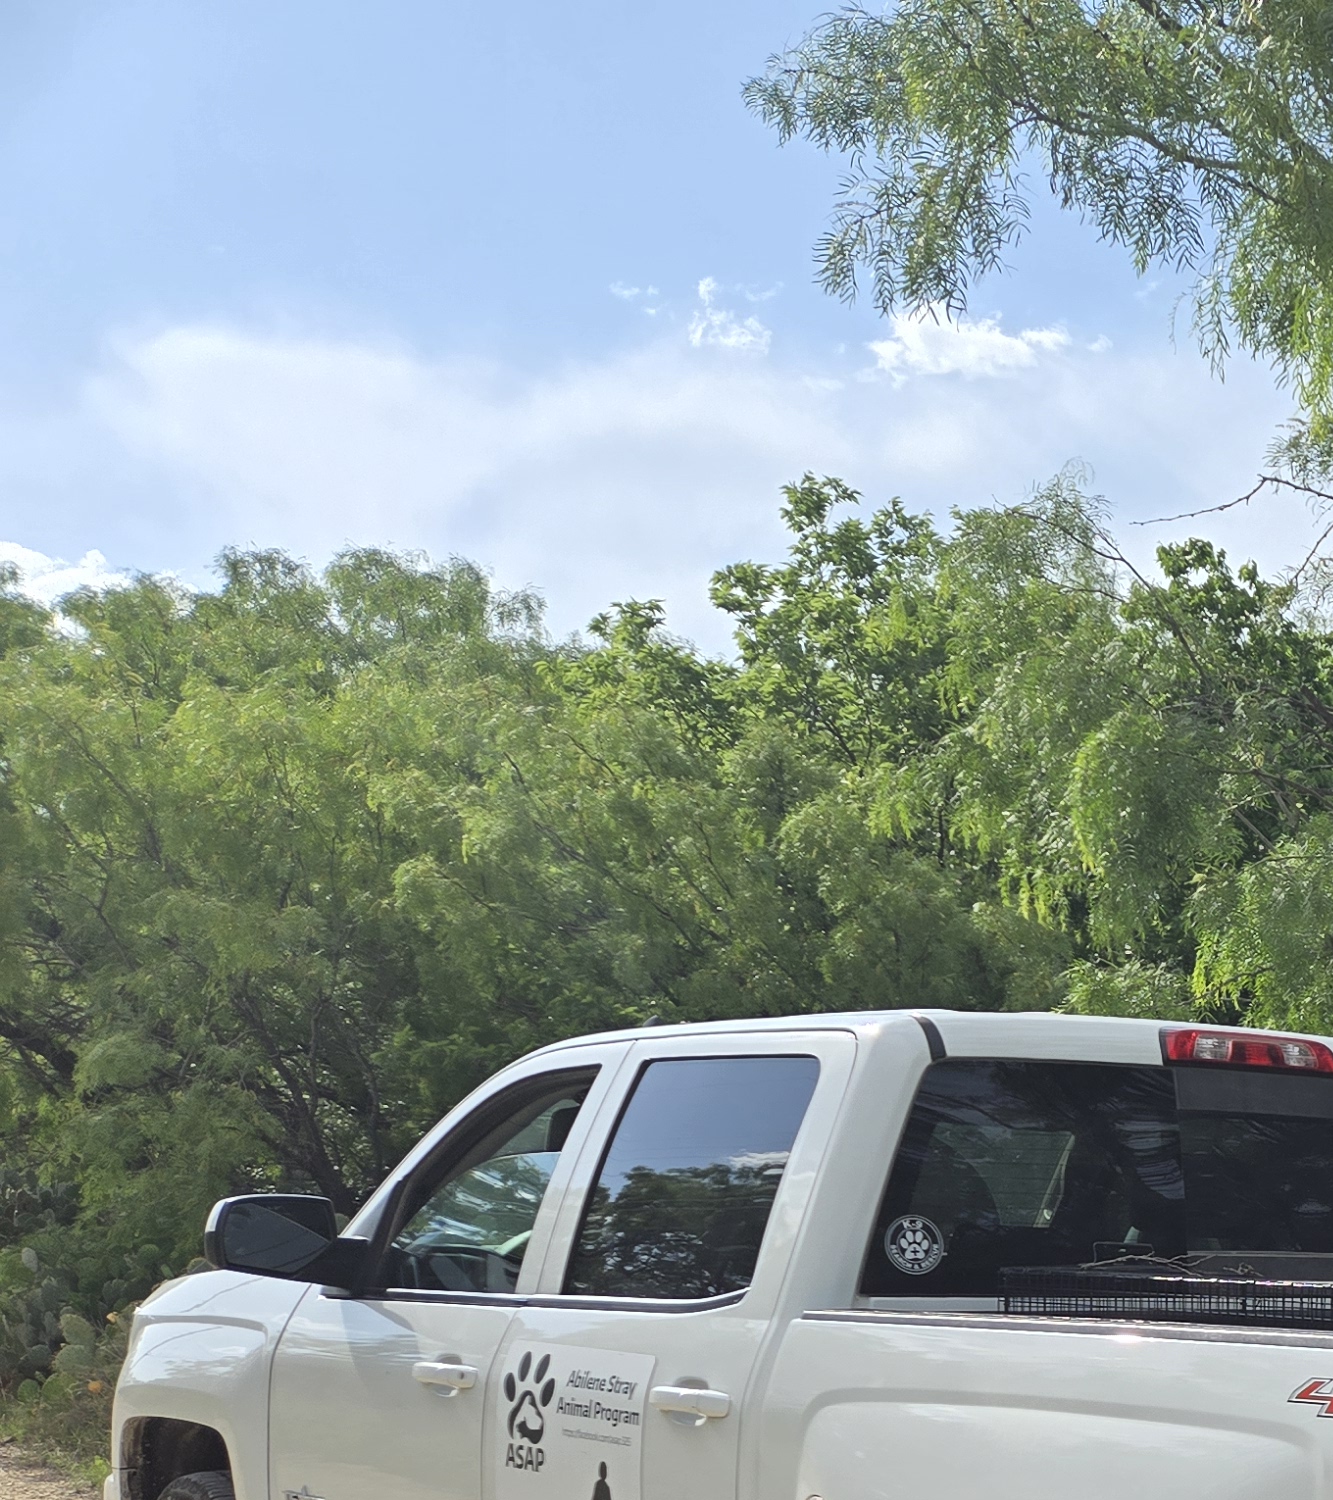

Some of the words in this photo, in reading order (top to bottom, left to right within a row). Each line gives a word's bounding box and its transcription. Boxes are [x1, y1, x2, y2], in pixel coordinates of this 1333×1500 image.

[566, 1370, 606, 1392] Abilene
[607, 1375, 639, 1400] Stray
[556, 1397, 592, 1419] Animal
[593, 1401, 640, 1427] Program
[505, 1443, 545, 1473] ASAP
